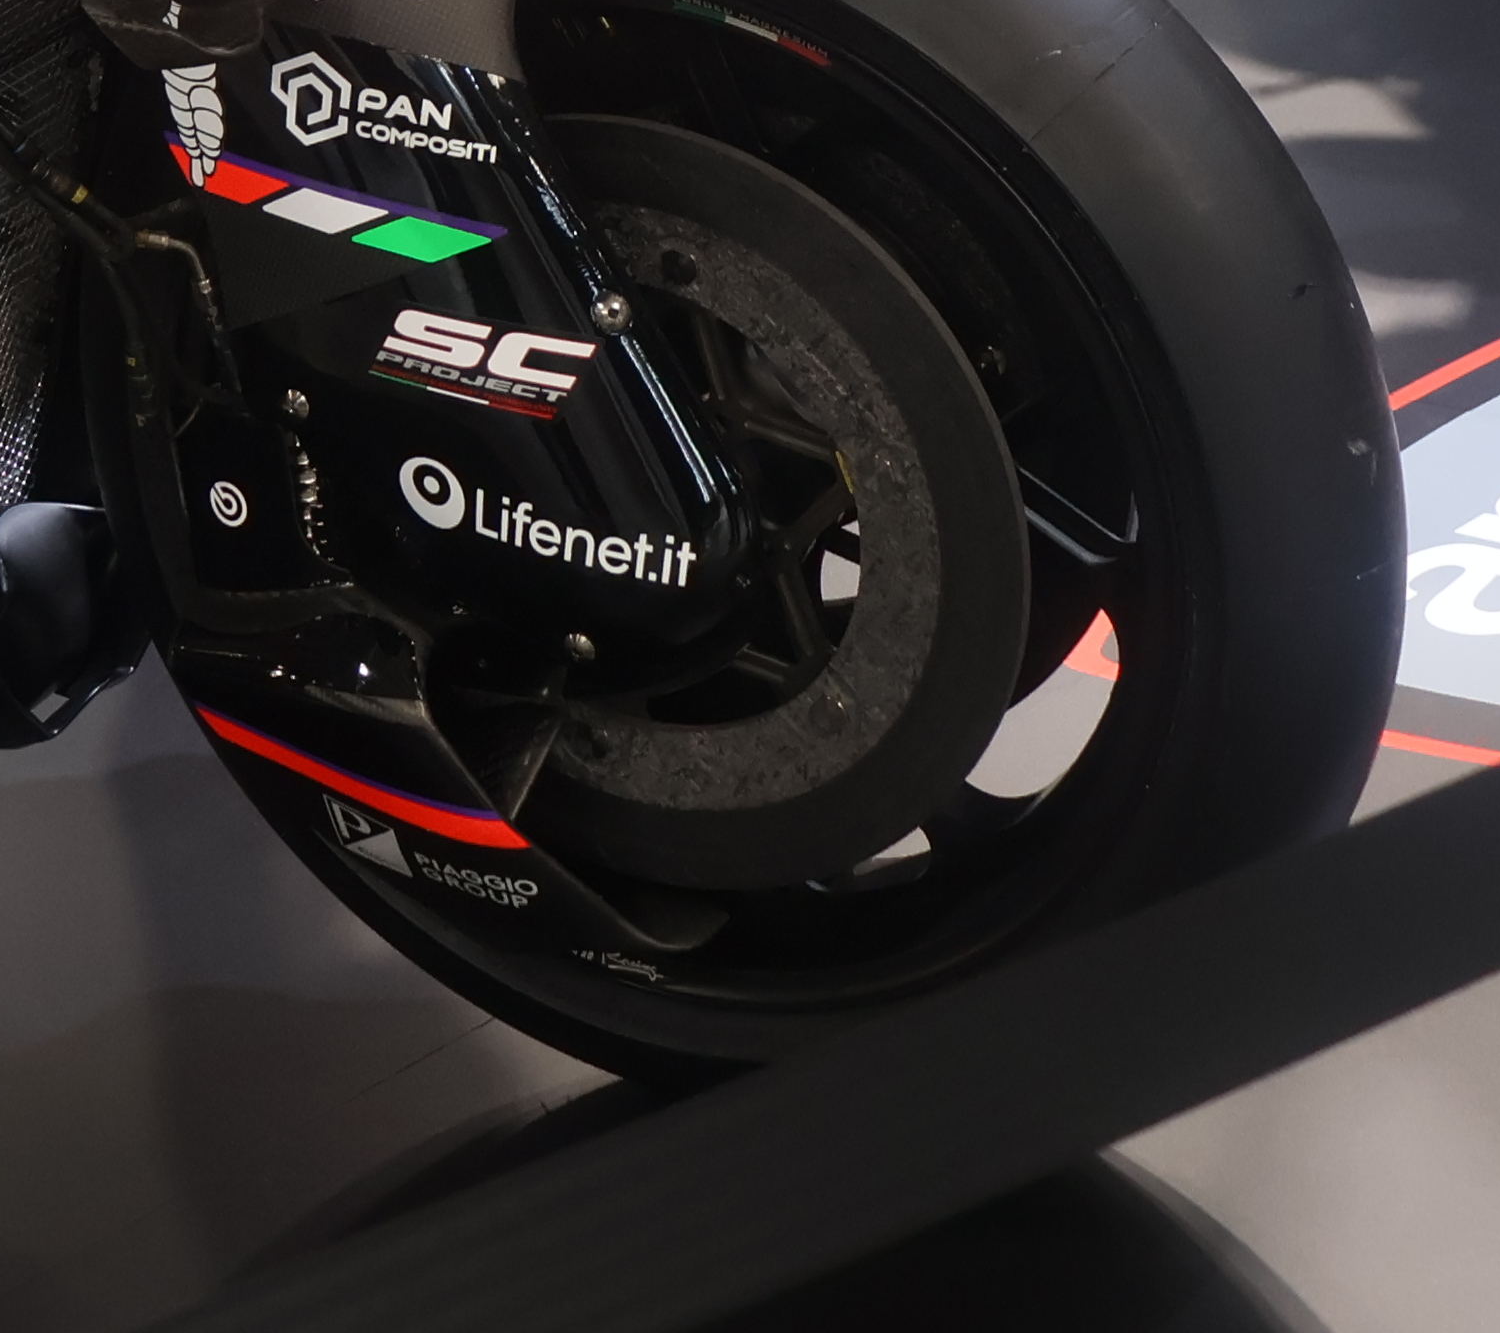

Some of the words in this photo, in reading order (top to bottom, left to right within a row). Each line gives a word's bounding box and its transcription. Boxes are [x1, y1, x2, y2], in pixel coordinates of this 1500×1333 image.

[356, 87, 455, 132] PAN
[354, 119, 498, 165] COMPOSITI
[382, 308, 598, 391] SC
[375, 349, 568, 403] PROJECT
[473, 487, 698, 588] Lifenet.it
[413, 850, 539, 897] PIAGGIO
[421, 866, 530, 910] GROUP
